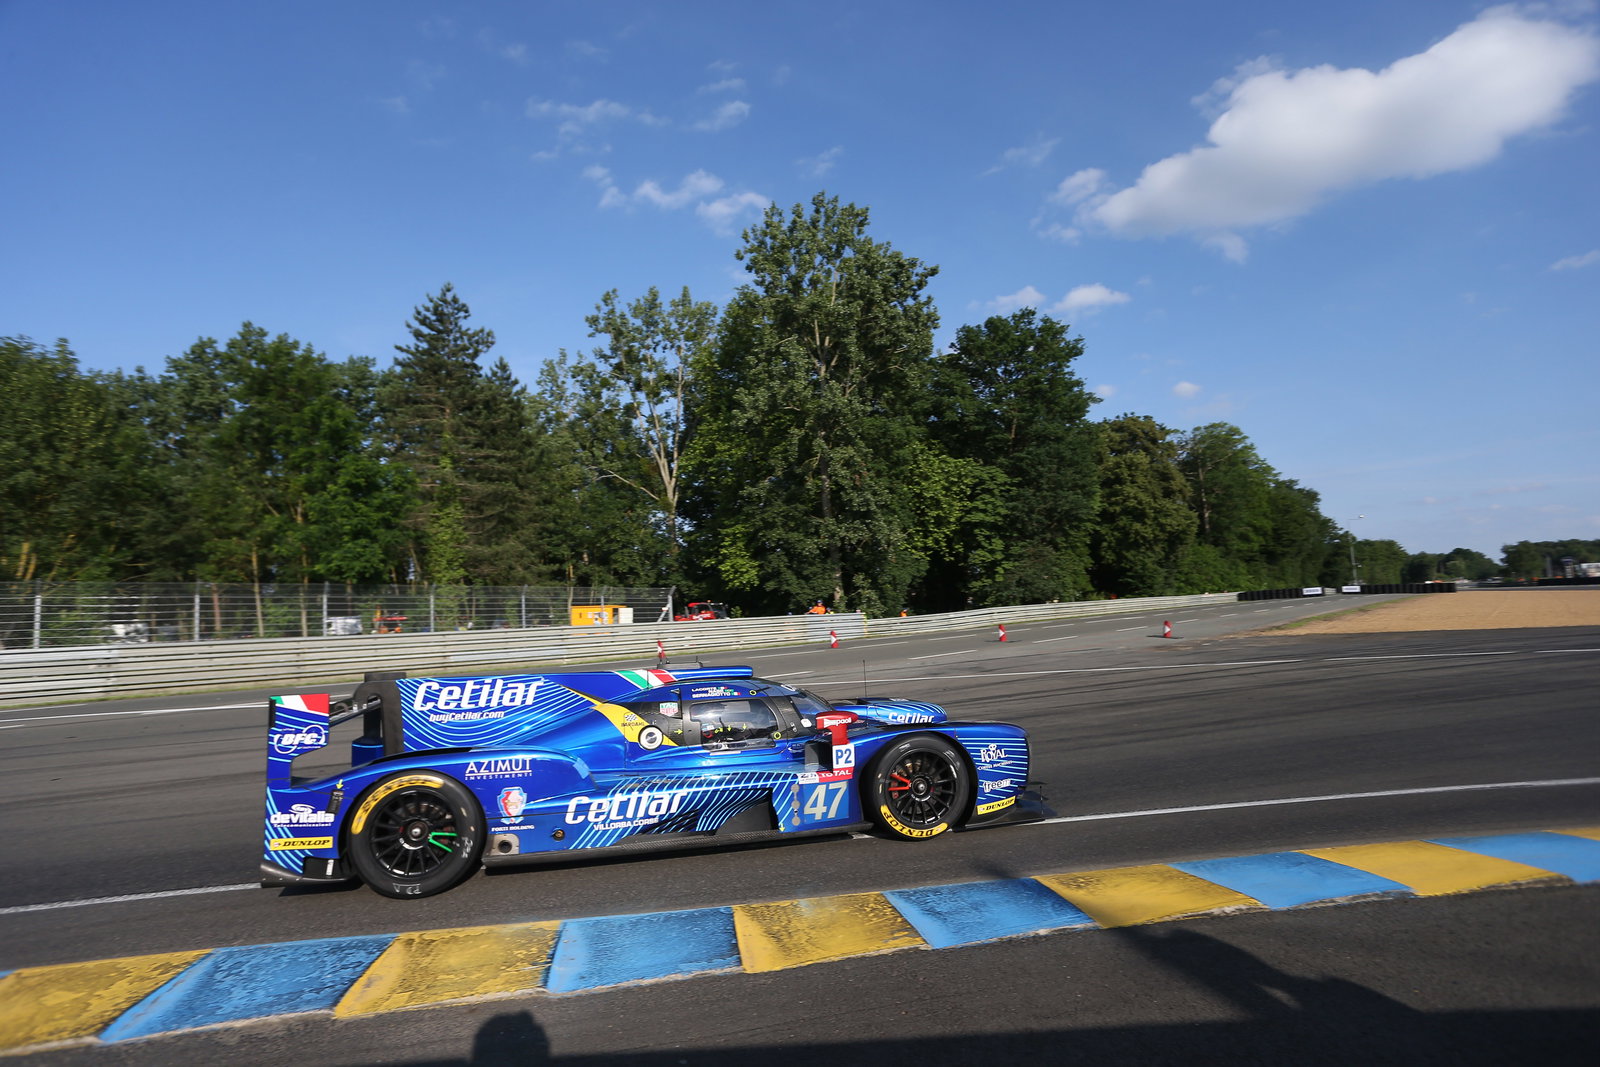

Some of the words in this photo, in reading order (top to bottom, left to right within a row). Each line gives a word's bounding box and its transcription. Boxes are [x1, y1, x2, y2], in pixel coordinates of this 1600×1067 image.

[413, 678, 545, 711] Cetilar
[429, 711, 505, 723] buyCetilar.com
[888, 712, 934, 724] Cetilar
[835, 748, 853, 765] P2
[980, 748, 1008, 763] ROYAL
[465, 758, 532, 774] AZIMUT
[820, 769, 852, 778] TOTAL
[565, 790, 687, 825] Cetilar
[803, 781, 848, 820] 47
[986, 799, 1014, 811] DUNLOP
[270, 811, 335, 824] devitalia
[593, 822, 632, 831] VILLORBA
[633, 817, 659, 826] CORSE
[884, 811, 933, 837] DUNLOP
[282, 839, 331, 848] DUNLOP
